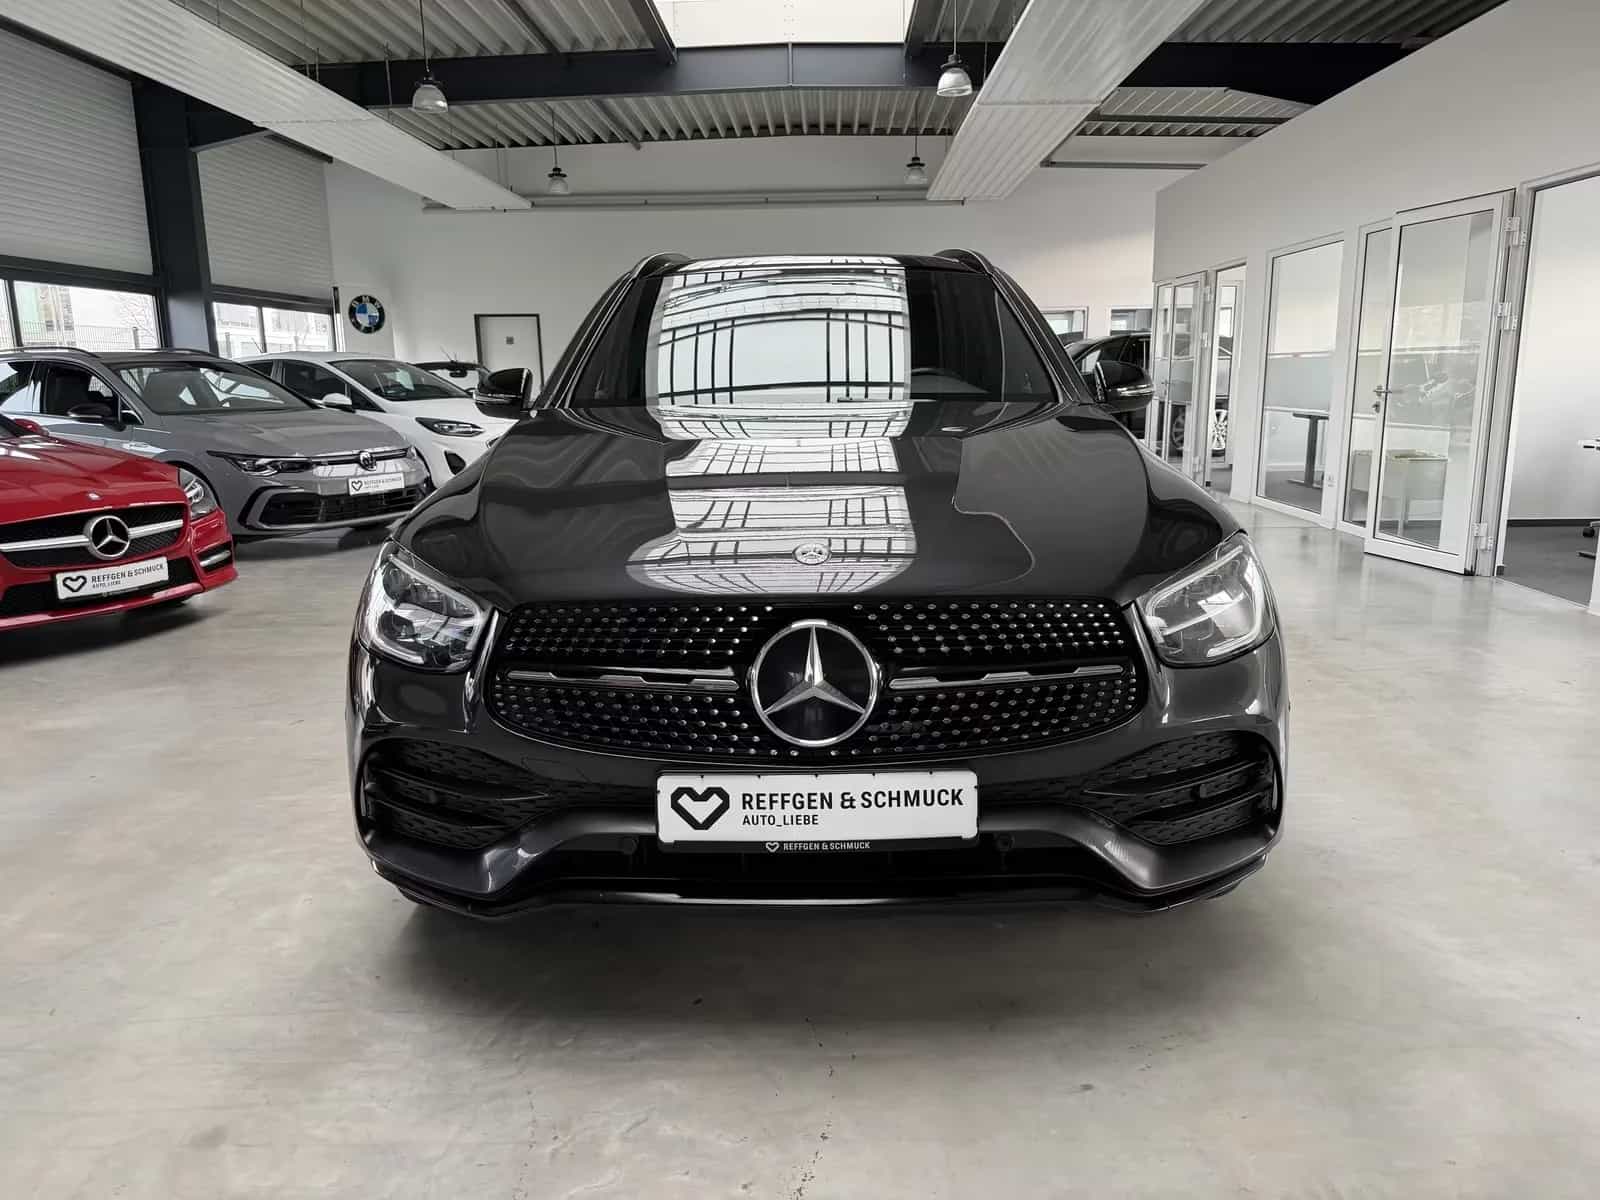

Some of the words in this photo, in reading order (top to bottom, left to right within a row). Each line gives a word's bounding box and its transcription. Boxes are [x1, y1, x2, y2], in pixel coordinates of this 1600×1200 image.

[91, 571, 126, 583] REFFGEN
[134, 563, 164, 576] SCHMUCK
[741, 792, 833, 810] REFFGEN
[840, 792, 857, 809] &
[860, 788, 964, 809] SCHMUCK
[742, 814, 819, 827] AUTO_LIEBE
[783, 842, 820, 851] REFFGEN
[822, 842, 829, 850] &
[829, 841, 871, 850] SCHMUCK
